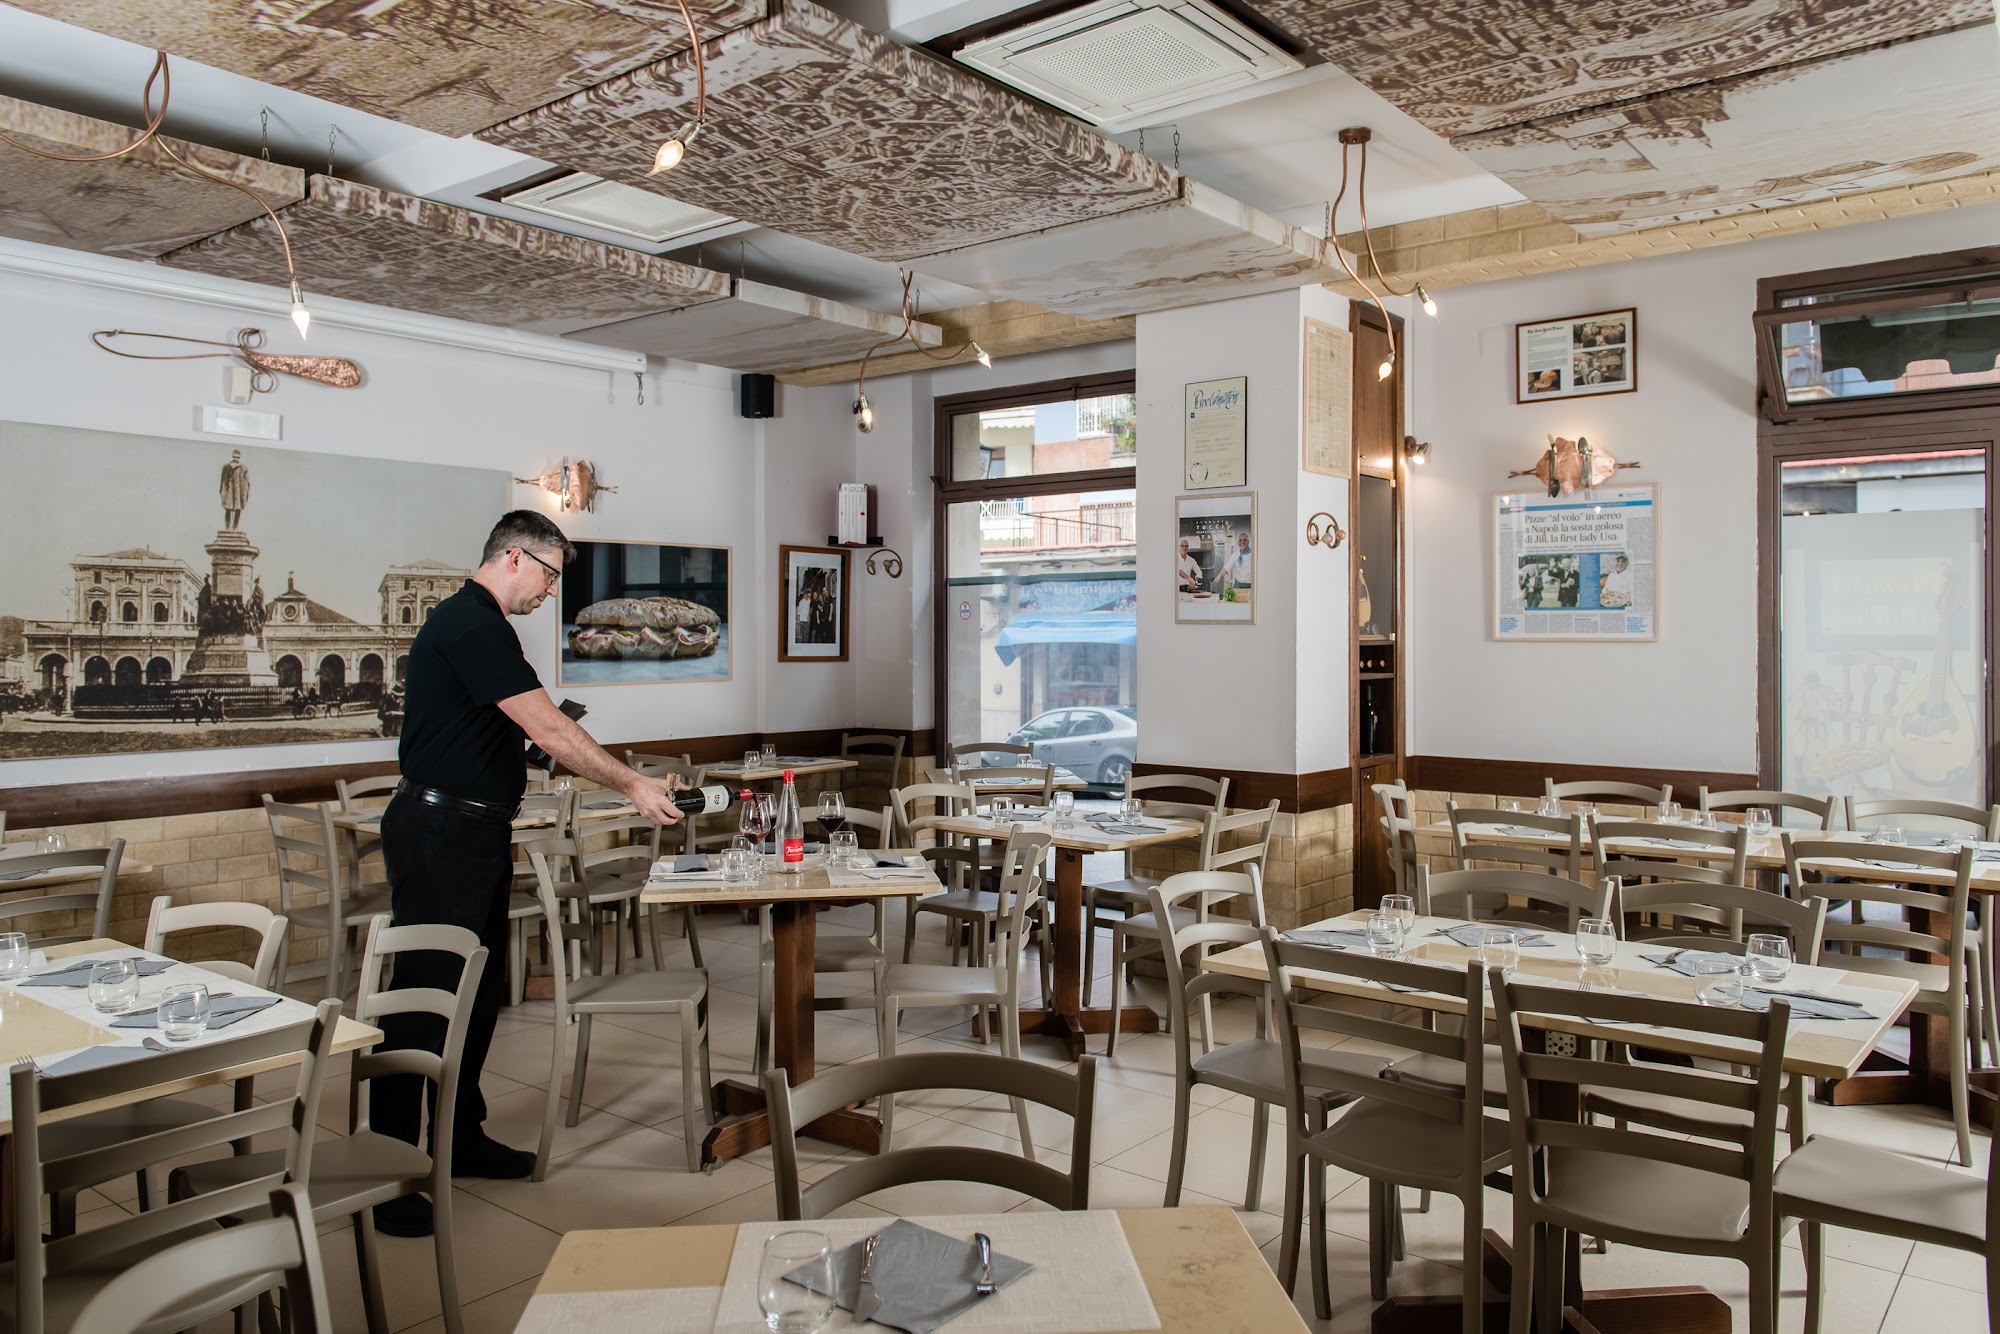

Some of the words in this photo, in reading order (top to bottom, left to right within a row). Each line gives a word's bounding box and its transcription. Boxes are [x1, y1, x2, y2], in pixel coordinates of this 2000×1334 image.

[1525, 514, 1546, 524] Pizze
[1586, 512, 1595, 521] in
[1531, 523, 1559, 536] Napoli
[1561, 523, 1569, 532] la
[1570, 523, 1594, 532] sosta
[1595, 522, 1624, 534] golosa
[1525, 534, 1533, 543] di
[1551, 533, 1559, 542] la
[1560, 533, 1577, 542] first
[1579, 532, 1598, 544] lady
[1600, 532, 1617, 541] Usa
